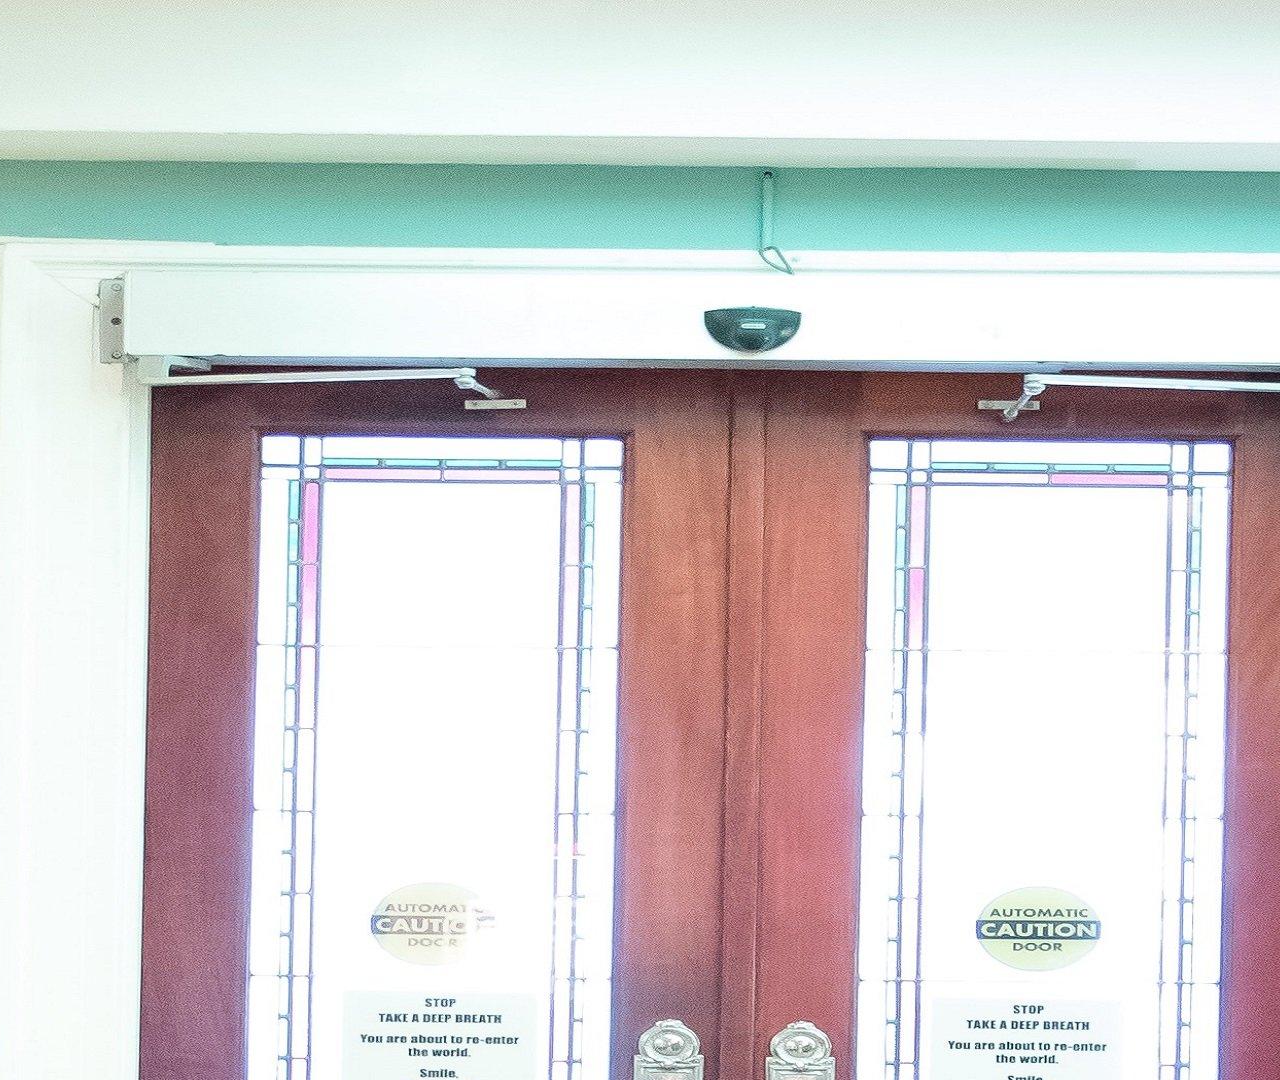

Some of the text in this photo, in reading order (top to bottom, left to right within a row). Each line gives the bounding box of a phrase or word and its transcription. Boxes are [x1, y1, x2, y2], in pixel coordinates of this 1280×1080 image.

[384, 903, 484, 913] AUTOMAT
[989, 907, 1089, 918] AUTOMATIC
[980, 922, 1097, 938] CAUTION
[1012, 942, 1063, 952] DOOR
[424, 998, 457, 1008] STOP
[1013, 1004, 1045, 1015] STOP
[378, 1012, 502, 1024] TAKE A DEEP BREATH
[966, 1019, 1090, 1031] TAKE A DEEP BREATH
[360, 1033, 520, 1045] You are about to re-enter
[947, 1040, 1108, 1052] You are about to re-enter
[408, 1047, 471, 1058] the world.
[995, 1053, 1059, 1065] the world.
[419, 1068, 459, 1079] Smile.
